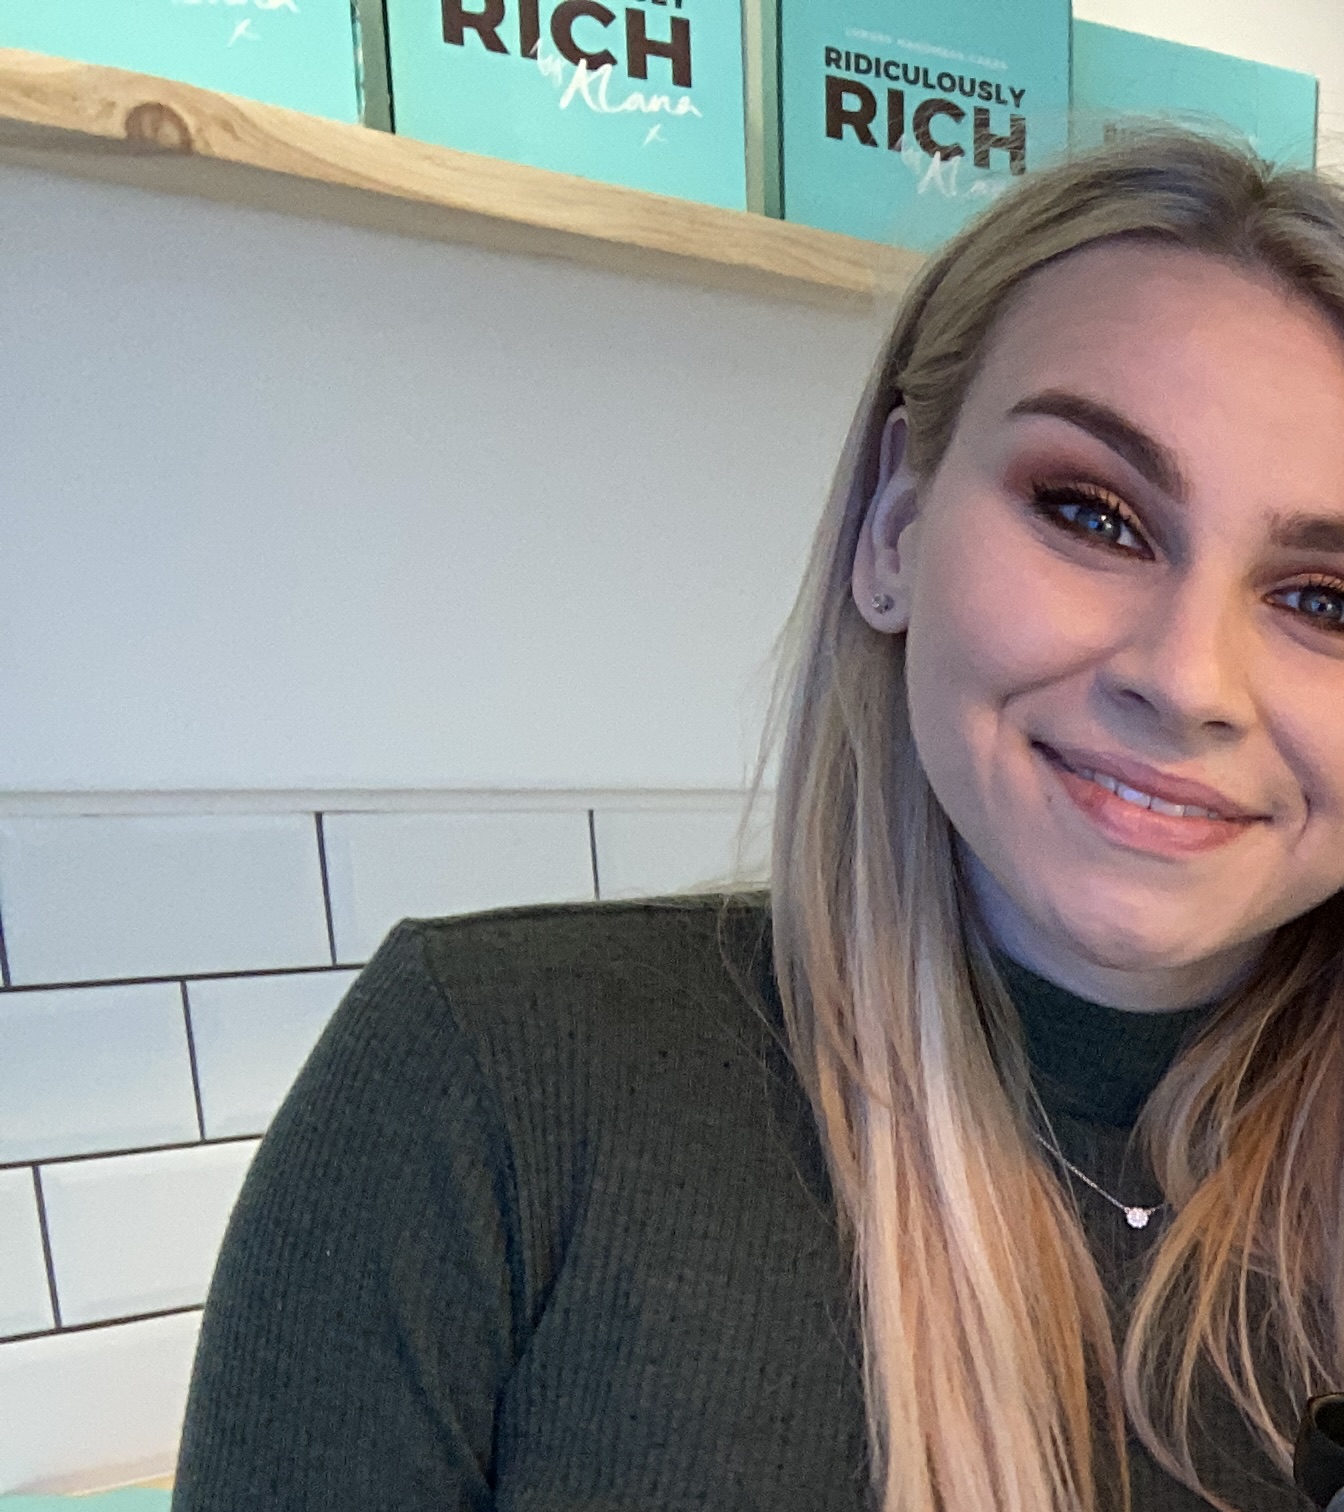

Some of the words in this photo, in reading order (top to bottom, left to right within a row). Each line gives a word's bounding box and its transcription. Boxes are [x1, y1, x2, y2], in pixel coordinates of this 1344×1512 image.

[441, 0, 692, 88] RICH
[824, 46, 1026, 108] RIDICULOUSLY
[824, 74, 1027, 176] RICH
